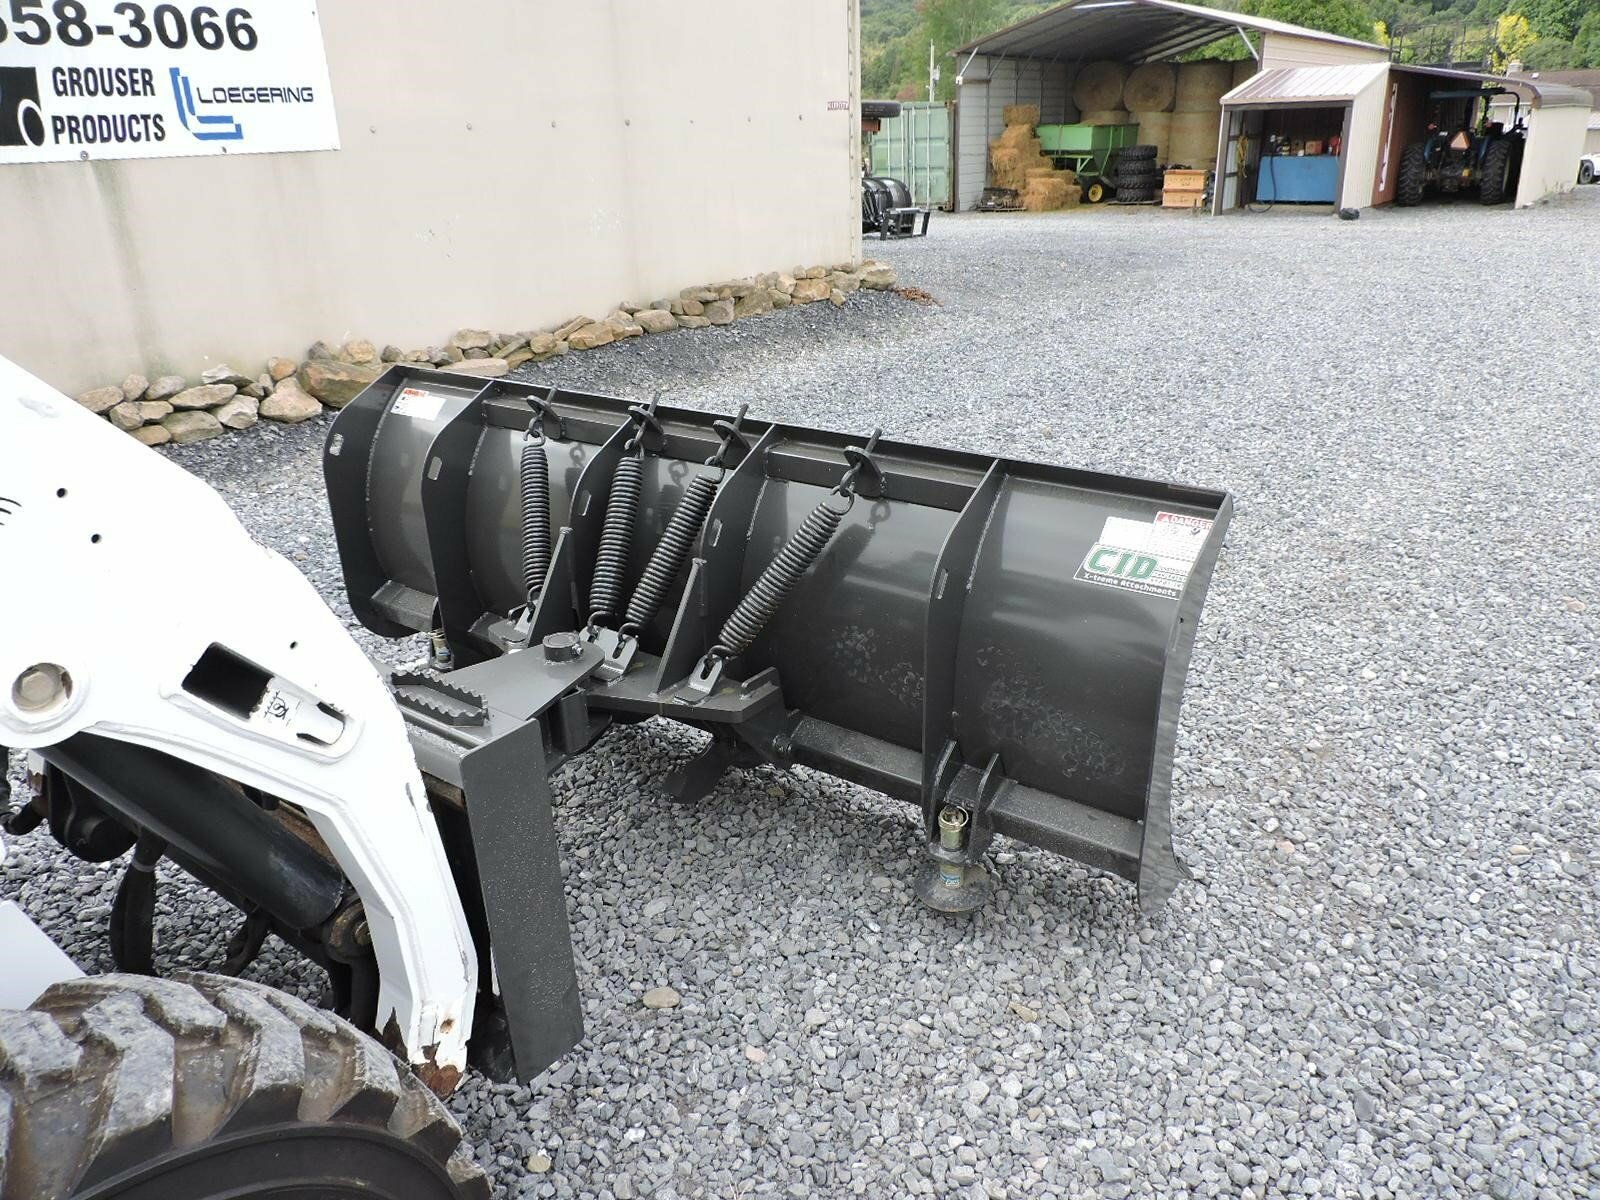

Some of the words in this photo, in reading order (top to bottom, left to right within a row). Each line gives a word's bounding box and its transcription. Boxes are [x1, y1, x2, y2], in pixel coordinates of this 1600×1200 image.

[0, 0, 258, 51] 58-3066
[52, 66, 156, 97] GROUSER
[196, 86, 314, 104] LOEGERING
[51, 114, 166, 145] PRODUCTS
[1171, 515, 1213, 530] DANGER
[1088, 549, 1158, 580] CID
[1083, 572, 1119, 585] X-treme
[1120, 579, 1177, 597] Attachments
